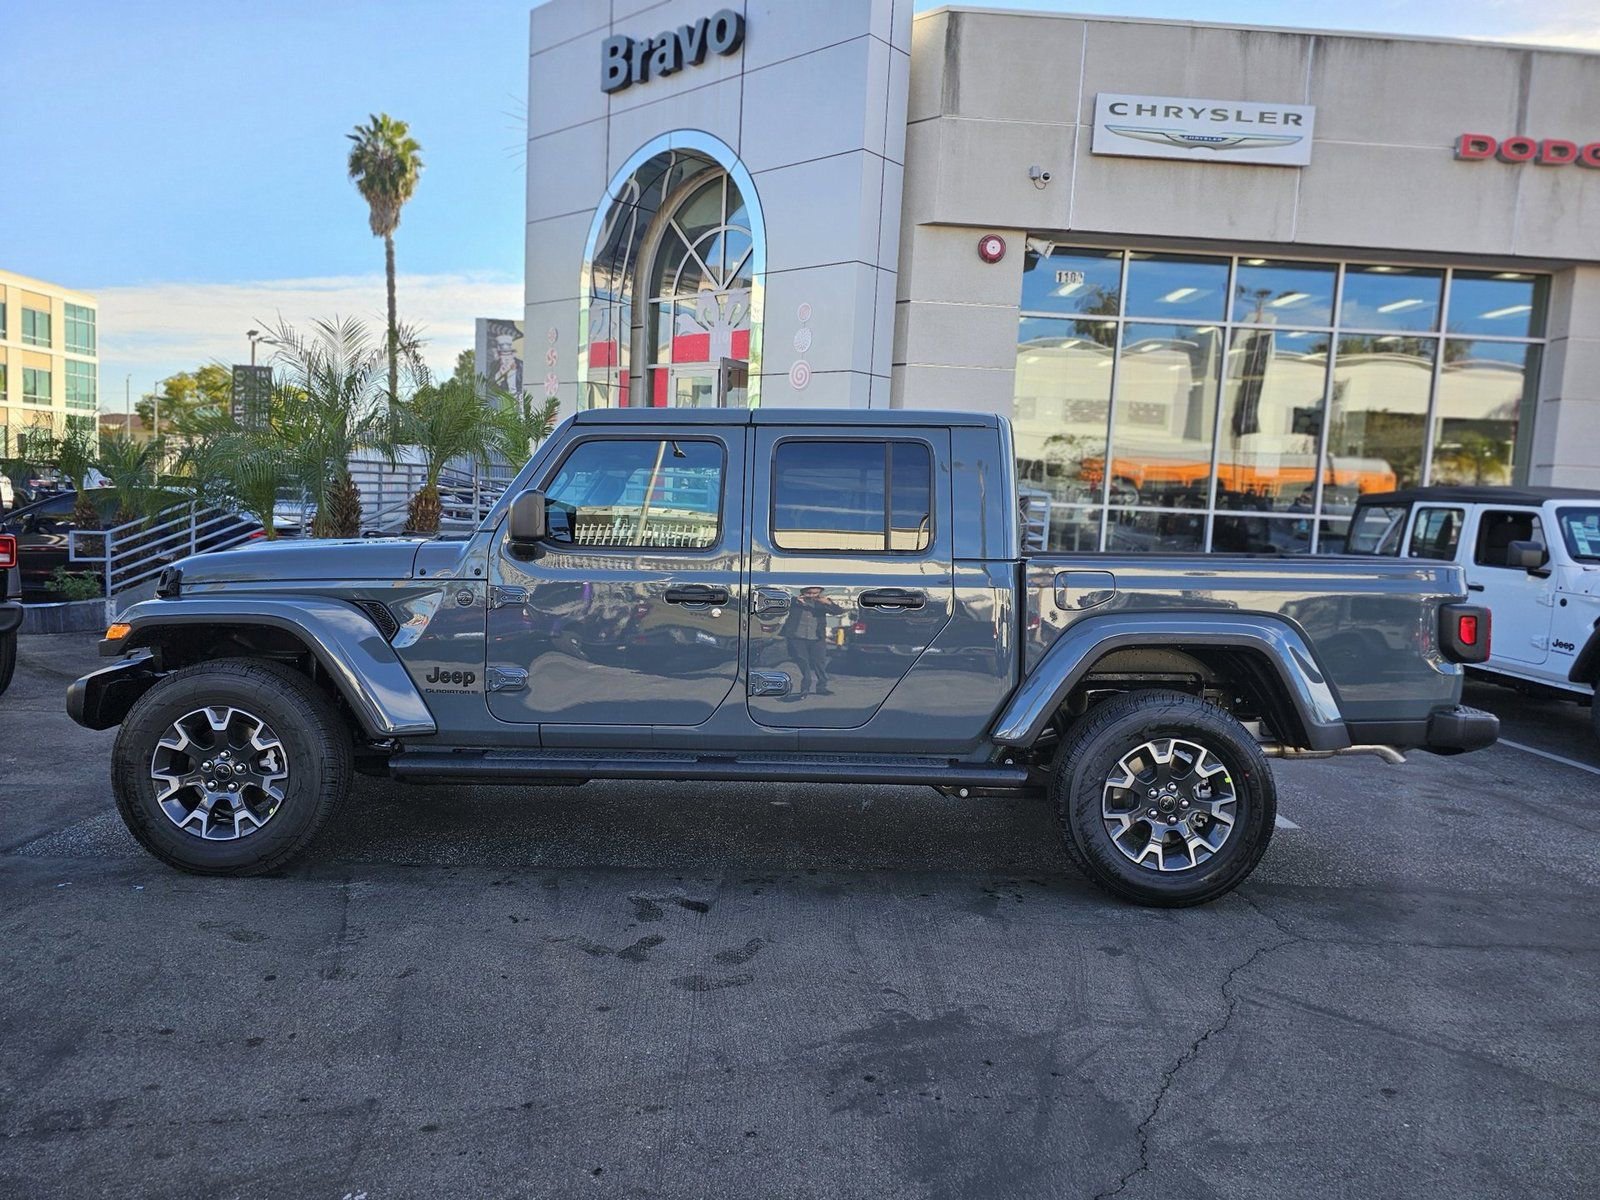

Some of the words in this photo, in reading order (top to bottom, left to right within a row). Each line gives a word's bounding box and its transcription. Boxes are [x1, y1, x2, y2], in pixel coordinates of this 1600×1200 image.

[601, 9, 745, 94] Bravo
[1108, 102, 1303, 127] CHRYSLER
[1552, 638, 1575, 652] Jeep
[425, 666, 476, 687] Jeep
